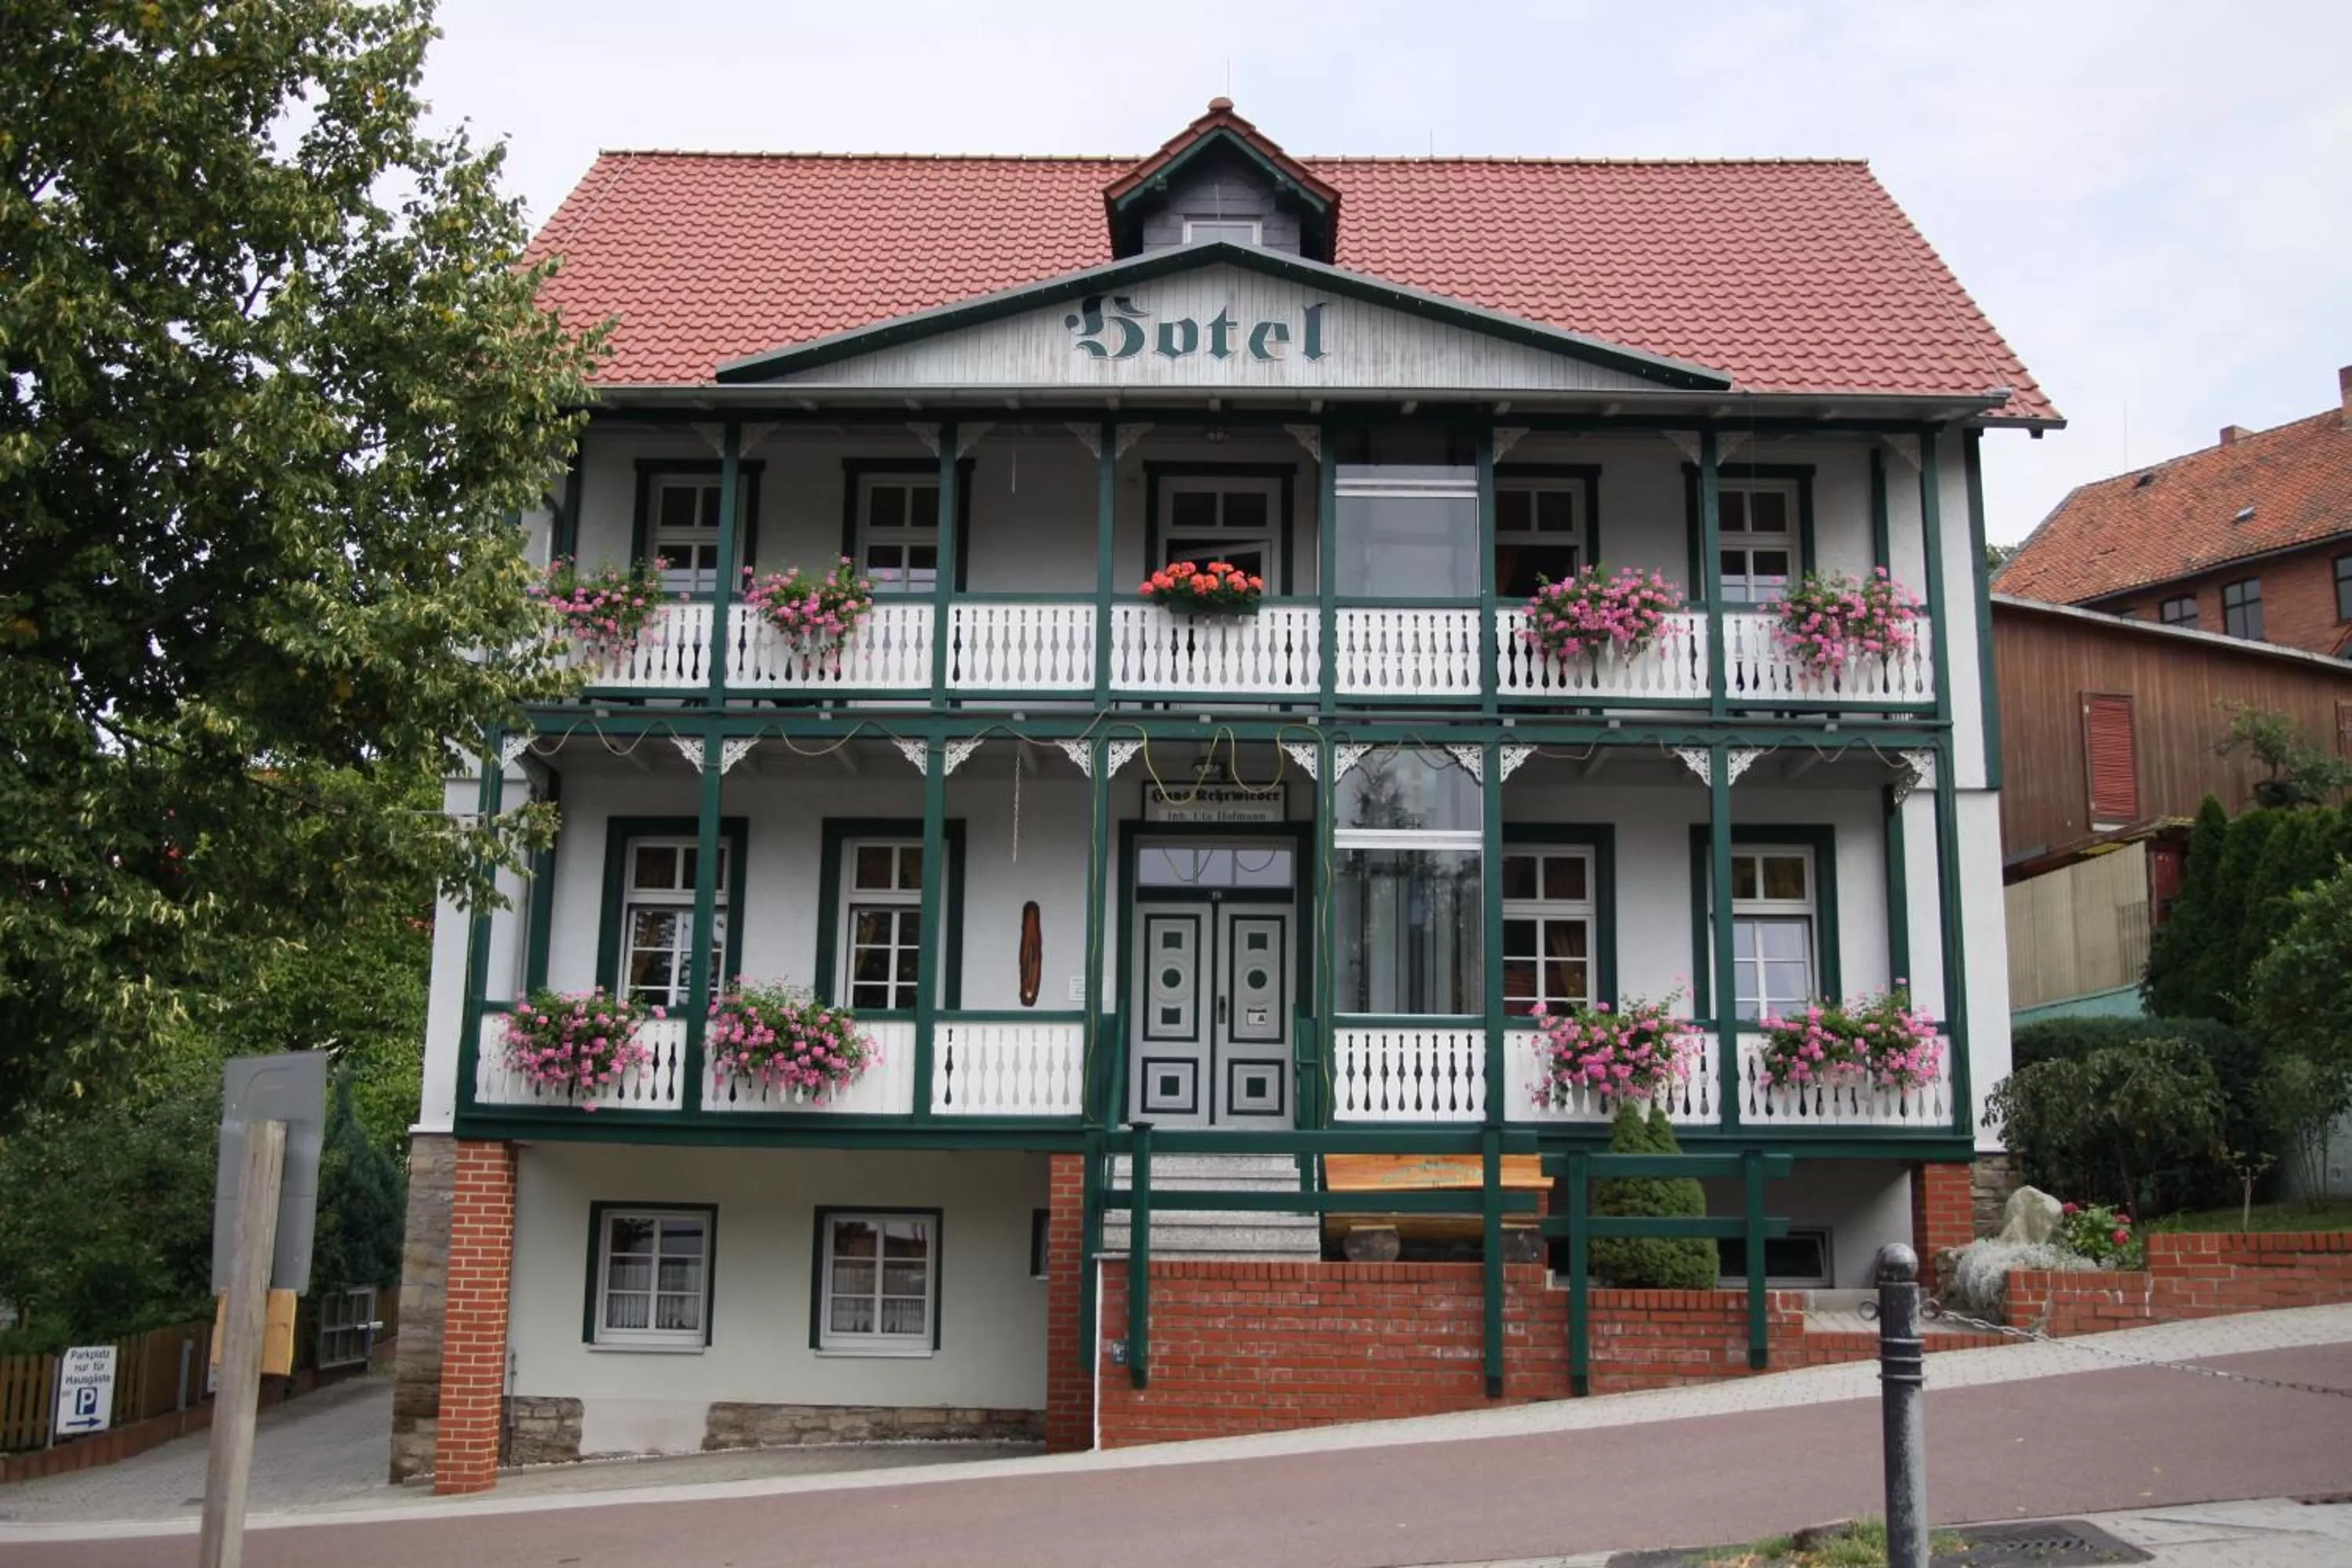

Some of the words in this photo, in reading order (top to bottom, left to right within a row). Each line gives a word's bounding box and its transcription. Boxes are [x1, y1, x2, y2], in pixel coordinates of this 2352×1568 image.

[1064, 295, 1332, 362] Hotel
[70, 1348, 111, 1361] Parkplatz
[74, 1363, 89, 1372] nur
[93, 1362, 105, 1371] für
[65, 1374, 111, 1385] Hausgäste
[79, 1388, 94, 1414] P
